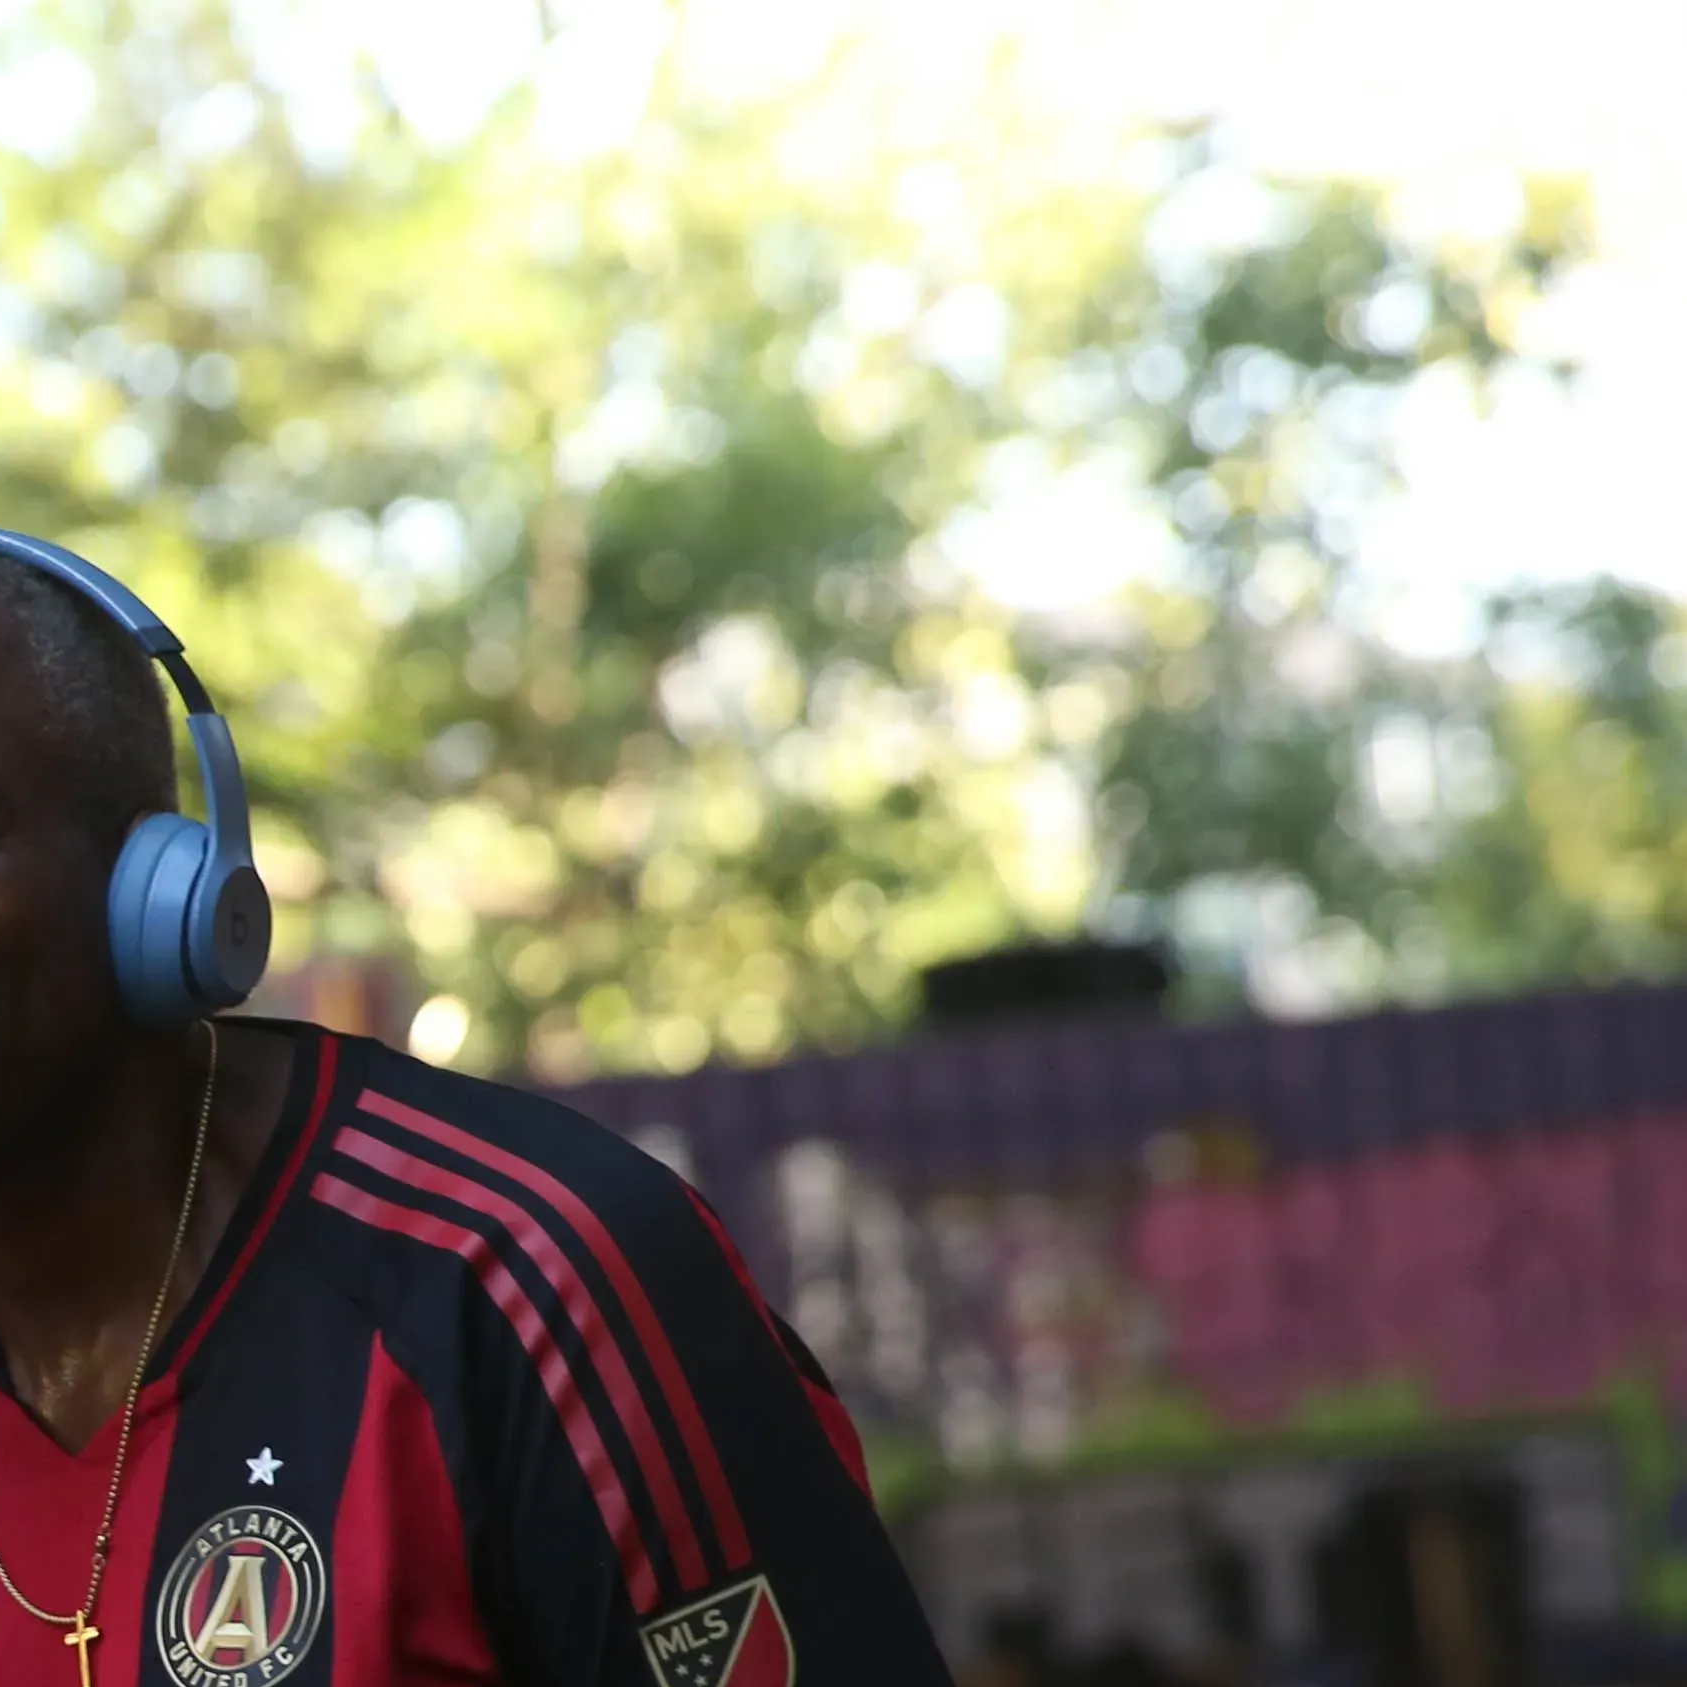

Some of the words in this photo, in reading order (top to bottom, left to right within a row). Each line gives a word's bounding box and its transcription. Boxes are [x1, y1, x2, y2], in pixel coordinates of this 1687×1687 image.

[195, 1512, 309, 1563] ATLANTA
[193, 1554, 270, 1668] A
[652, 1608, 730, 1661] MLS
[257, 1645, 295, 1680] FC
